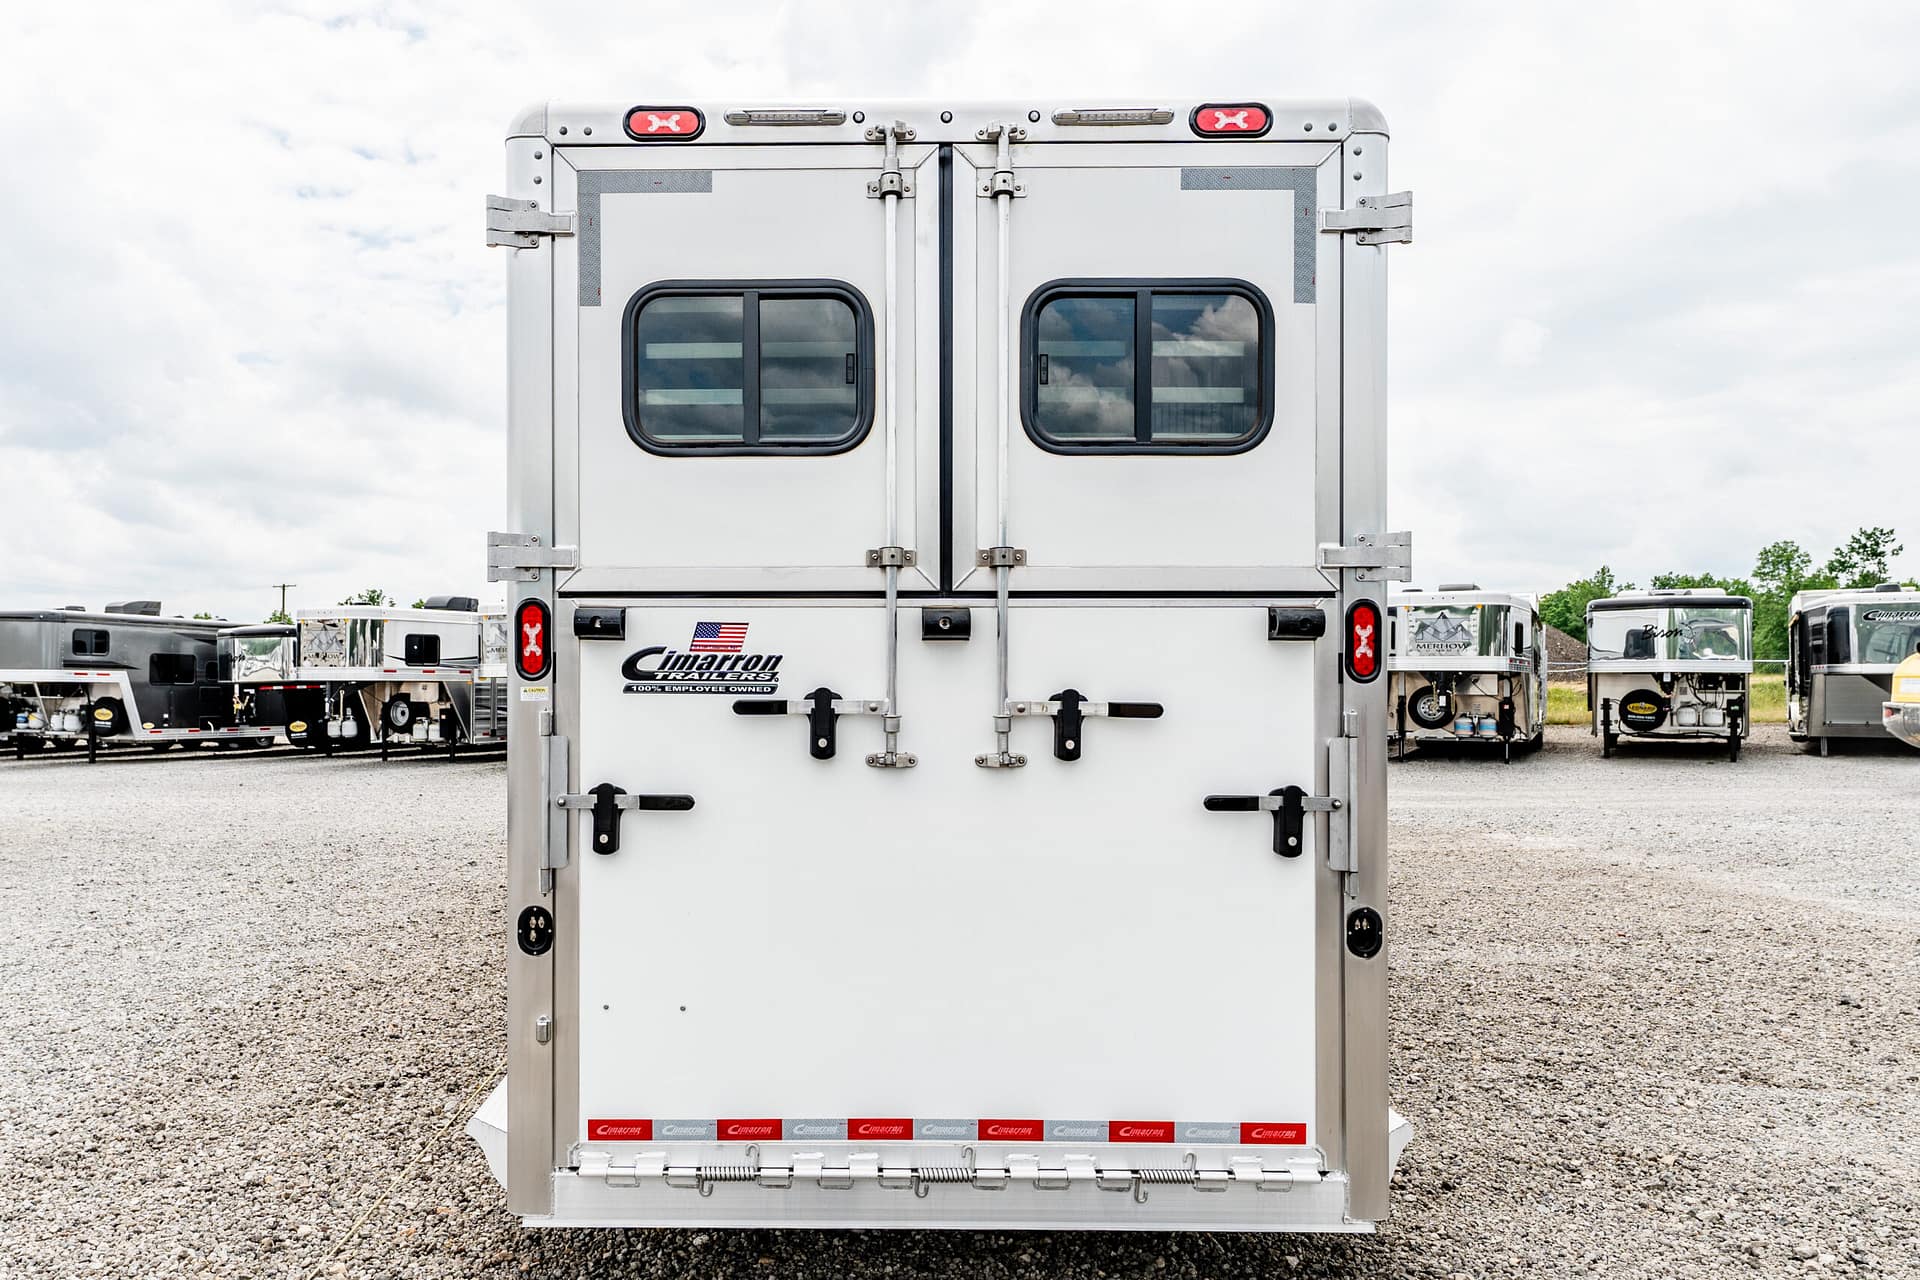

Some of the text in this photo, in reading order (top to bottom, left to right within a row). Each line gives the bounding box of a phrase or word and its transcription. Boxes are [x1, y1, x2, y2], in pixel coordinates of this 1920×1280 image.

[1641, 624, 1683, 640] Bison
[621, 646, 783, 681] Cimarron
[653, 671, 775, 681] TRAILERS
[729, 685, 772, 693] OWNED
